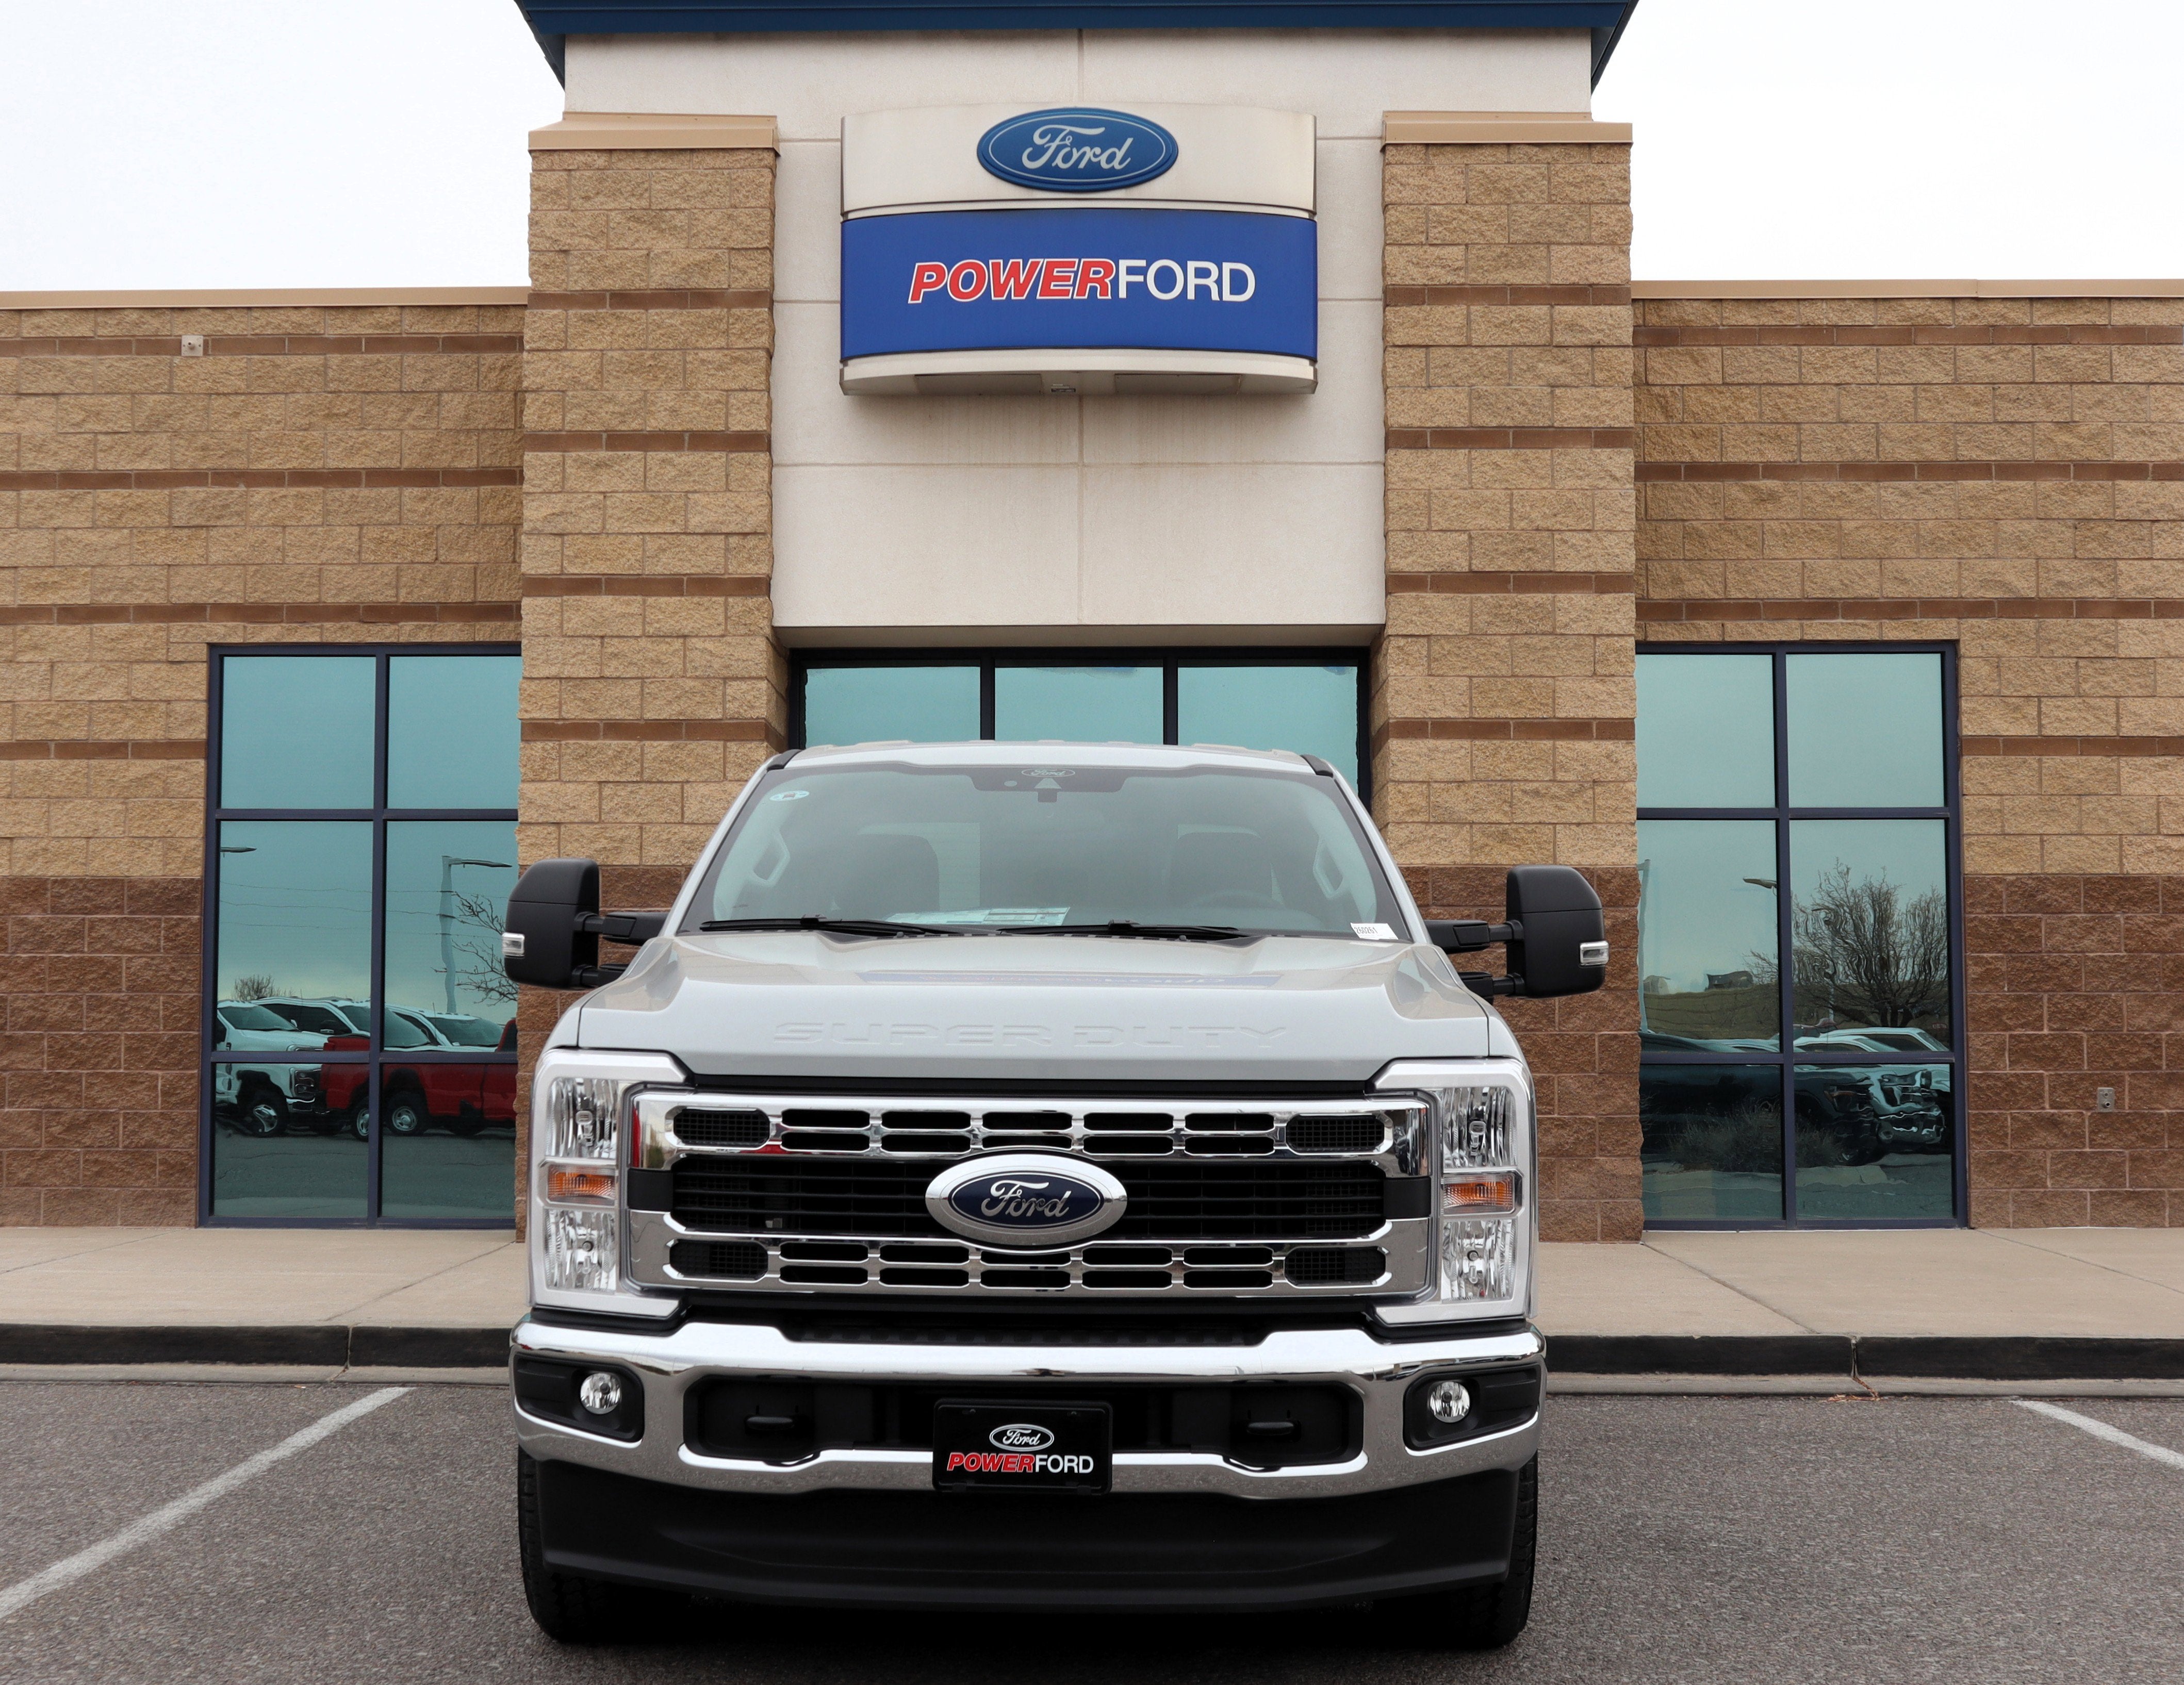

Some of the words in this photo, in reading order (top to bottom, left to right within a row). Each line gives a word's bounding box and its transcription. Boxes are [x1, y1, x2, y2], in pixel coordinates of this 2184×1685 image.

[1022, 125, 1134, 170] Ford
[774, 1023, 1052, 1046] SUPER
[1075, 1026, 1286, 1047] DUTY
[981, 1180, 1071, 1217] Ford
[1003, 1429, 1041, 1445] Ford
